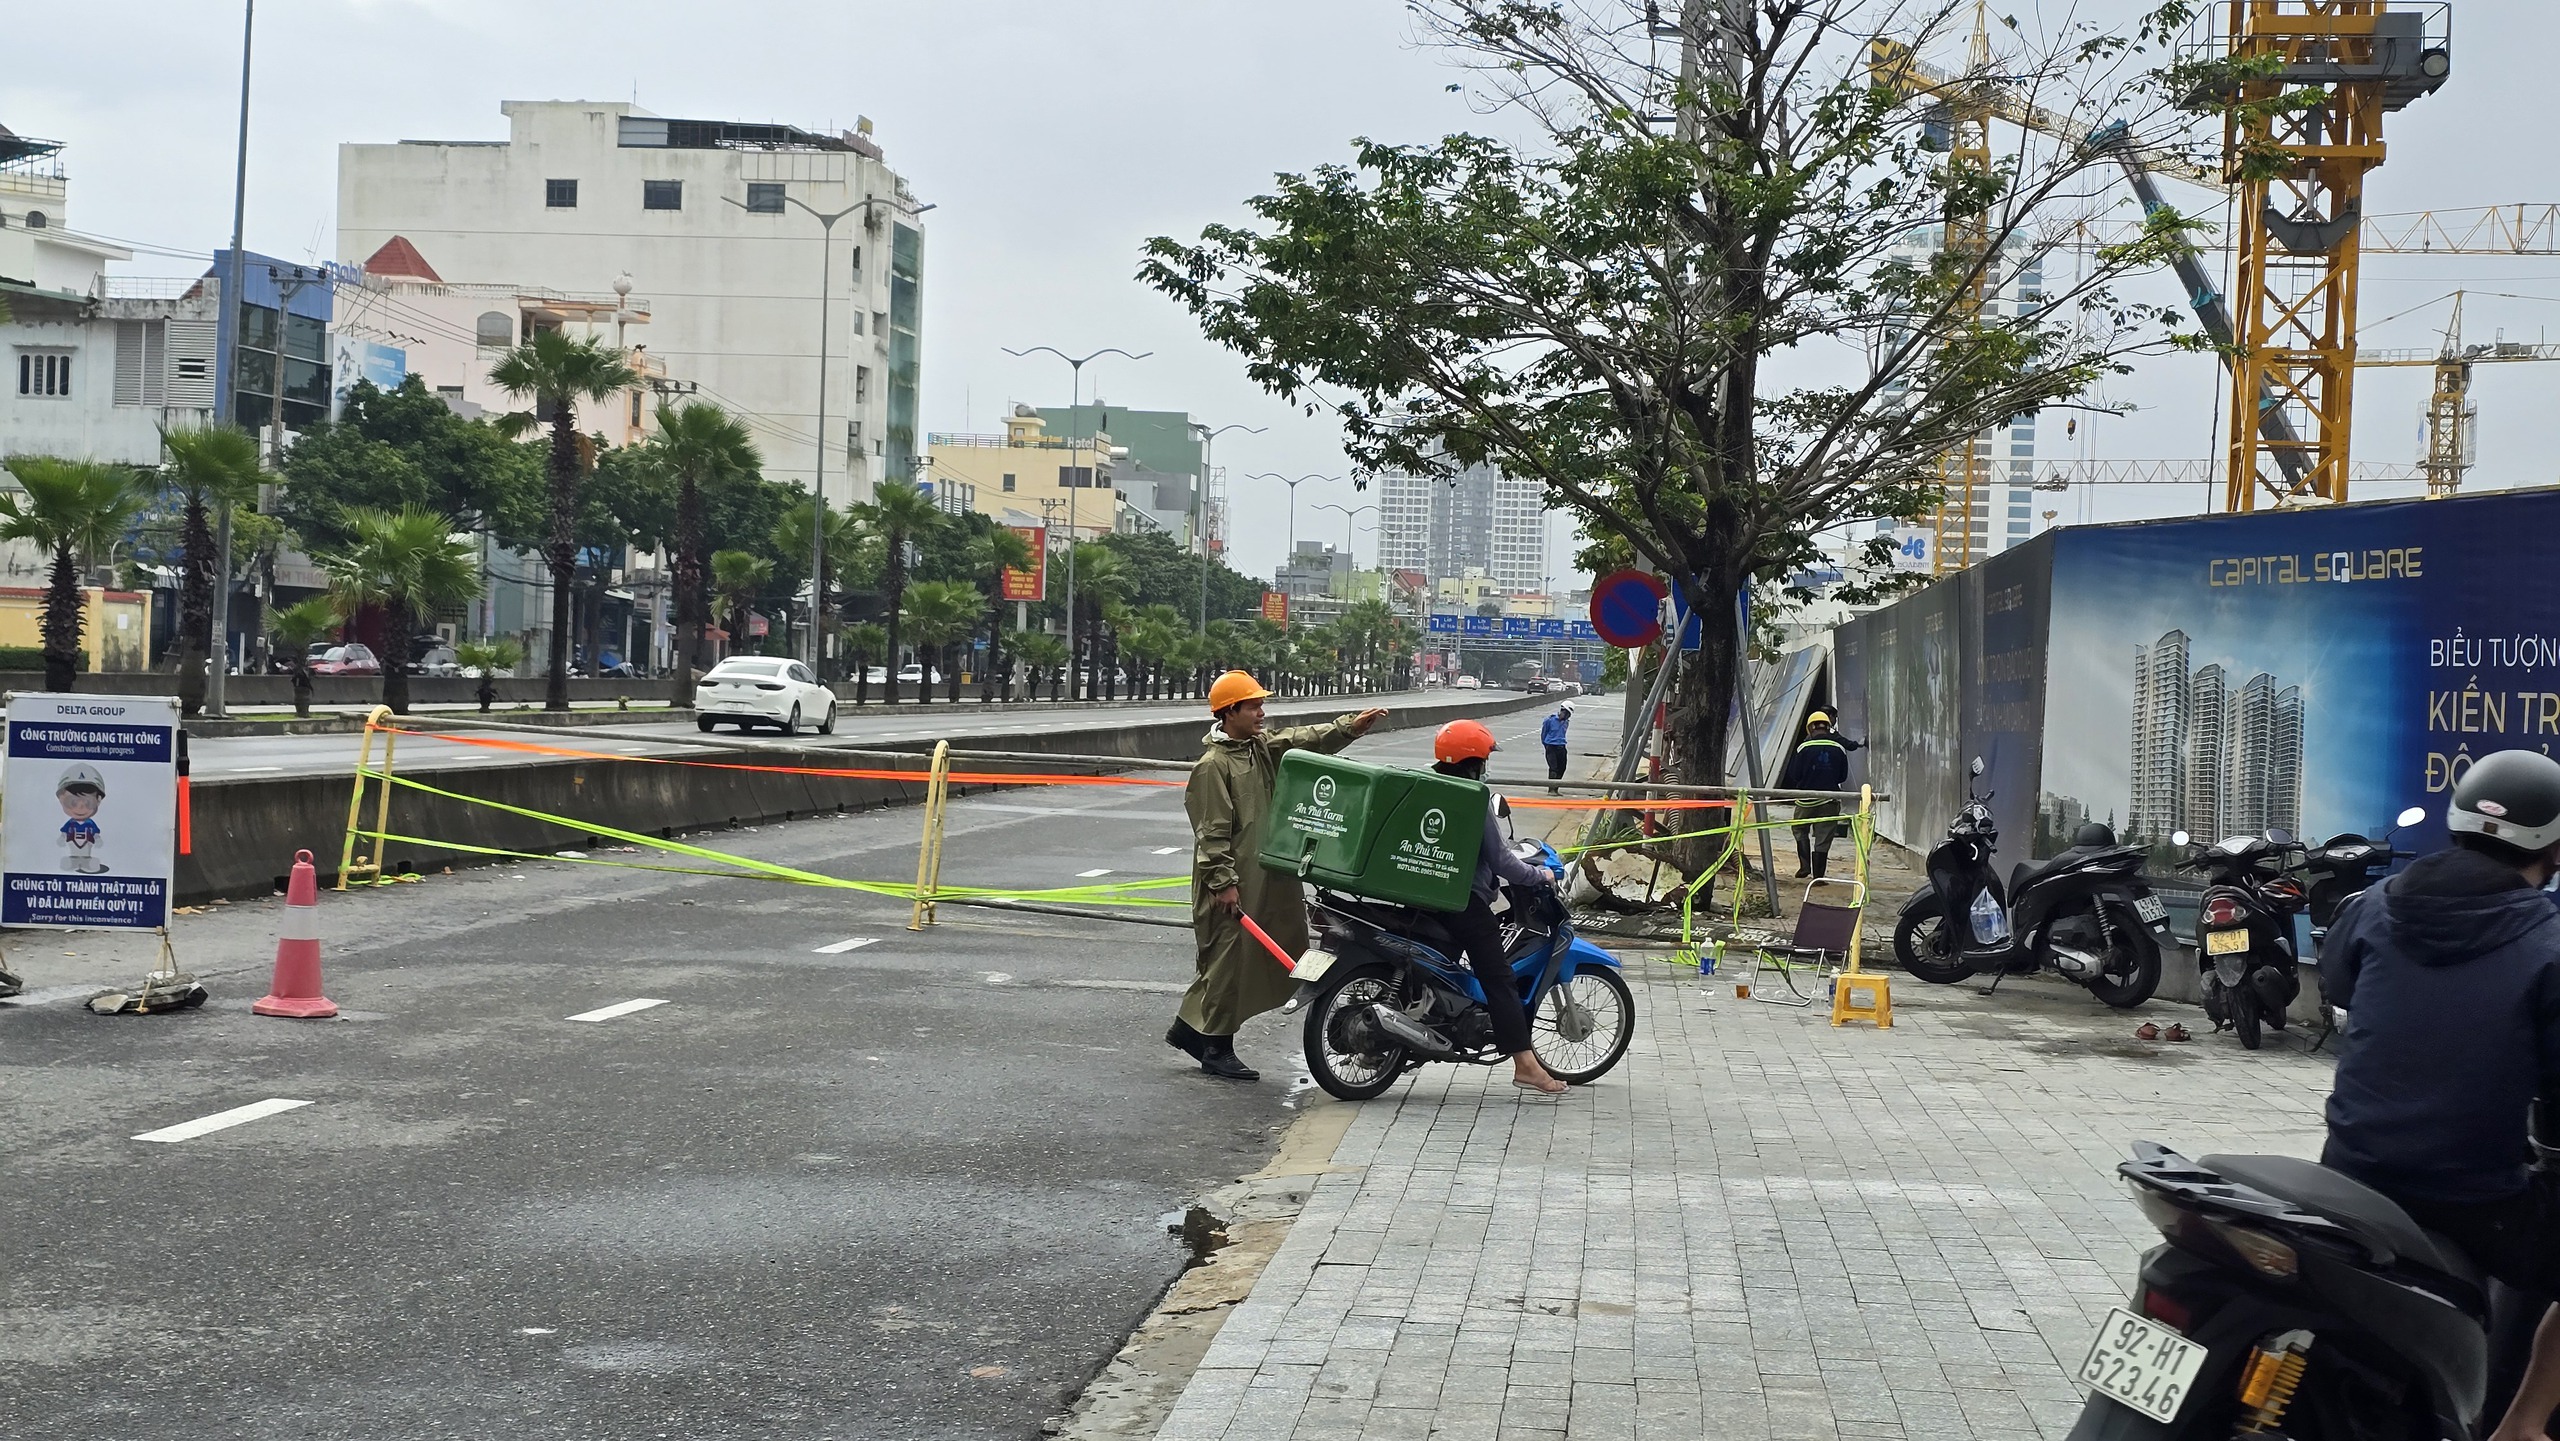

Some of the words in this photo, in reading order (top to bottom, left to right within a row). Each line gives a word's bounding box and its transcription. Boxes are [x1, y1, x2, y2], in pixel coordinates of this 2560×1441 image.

[1068, 436, 1094, 448] Hotel
[2210, 554, 2311, 587] CAPITAL
[2314, 547, 2423, 583] SQUARE
[2430, 626, 2482, 667] BIỂU
[2489, 633, 2560, 673] TƯỢN
[57, 705, 87, 715] DELTA
[90, 706, 126, 716] GROUP
[2429, 674, 2506, 734] KIẾN
[20, 728, 46, 740] CÔNG
[48, 729, 88, 742] TRƯỜNG
[89, 732, 116, 744] ĐANG
[117, 732, 133, 744] THI
[136, 732, 160, 745] CÔNG
[46, 743, 84, 752] Construction
[86, 746, 100, 754] work
[109, 747, 135, 756] progress
[1294, 802, 1306, 814] An
[1399, 840, 1412, 852] An
[1414, 842, 1430, 856] Phú
[1432, 846, 1454, 861] Farm
[10, 878, 44, 891] CHÚNG
[46, 878, 62, 892] TÔI
[66, 880, 98, 893] THÀNH
[101, 880, 125, 897] THẬT
[126, 883, 142, 895] XIN
[144, 880, 160, 896] LỖI
[26, 894, 36, 908] VÌ
[38, 896, 52, 908] ĐÃ
[54, 896, 74, 910] LÀM
[107, 898, 126, 912] QUÝ
[55, 914, 67, 922] for
[2114, 1320, 2188, 1376] 92-H1
[2088, 1348, 2180, 1414] 523.46
